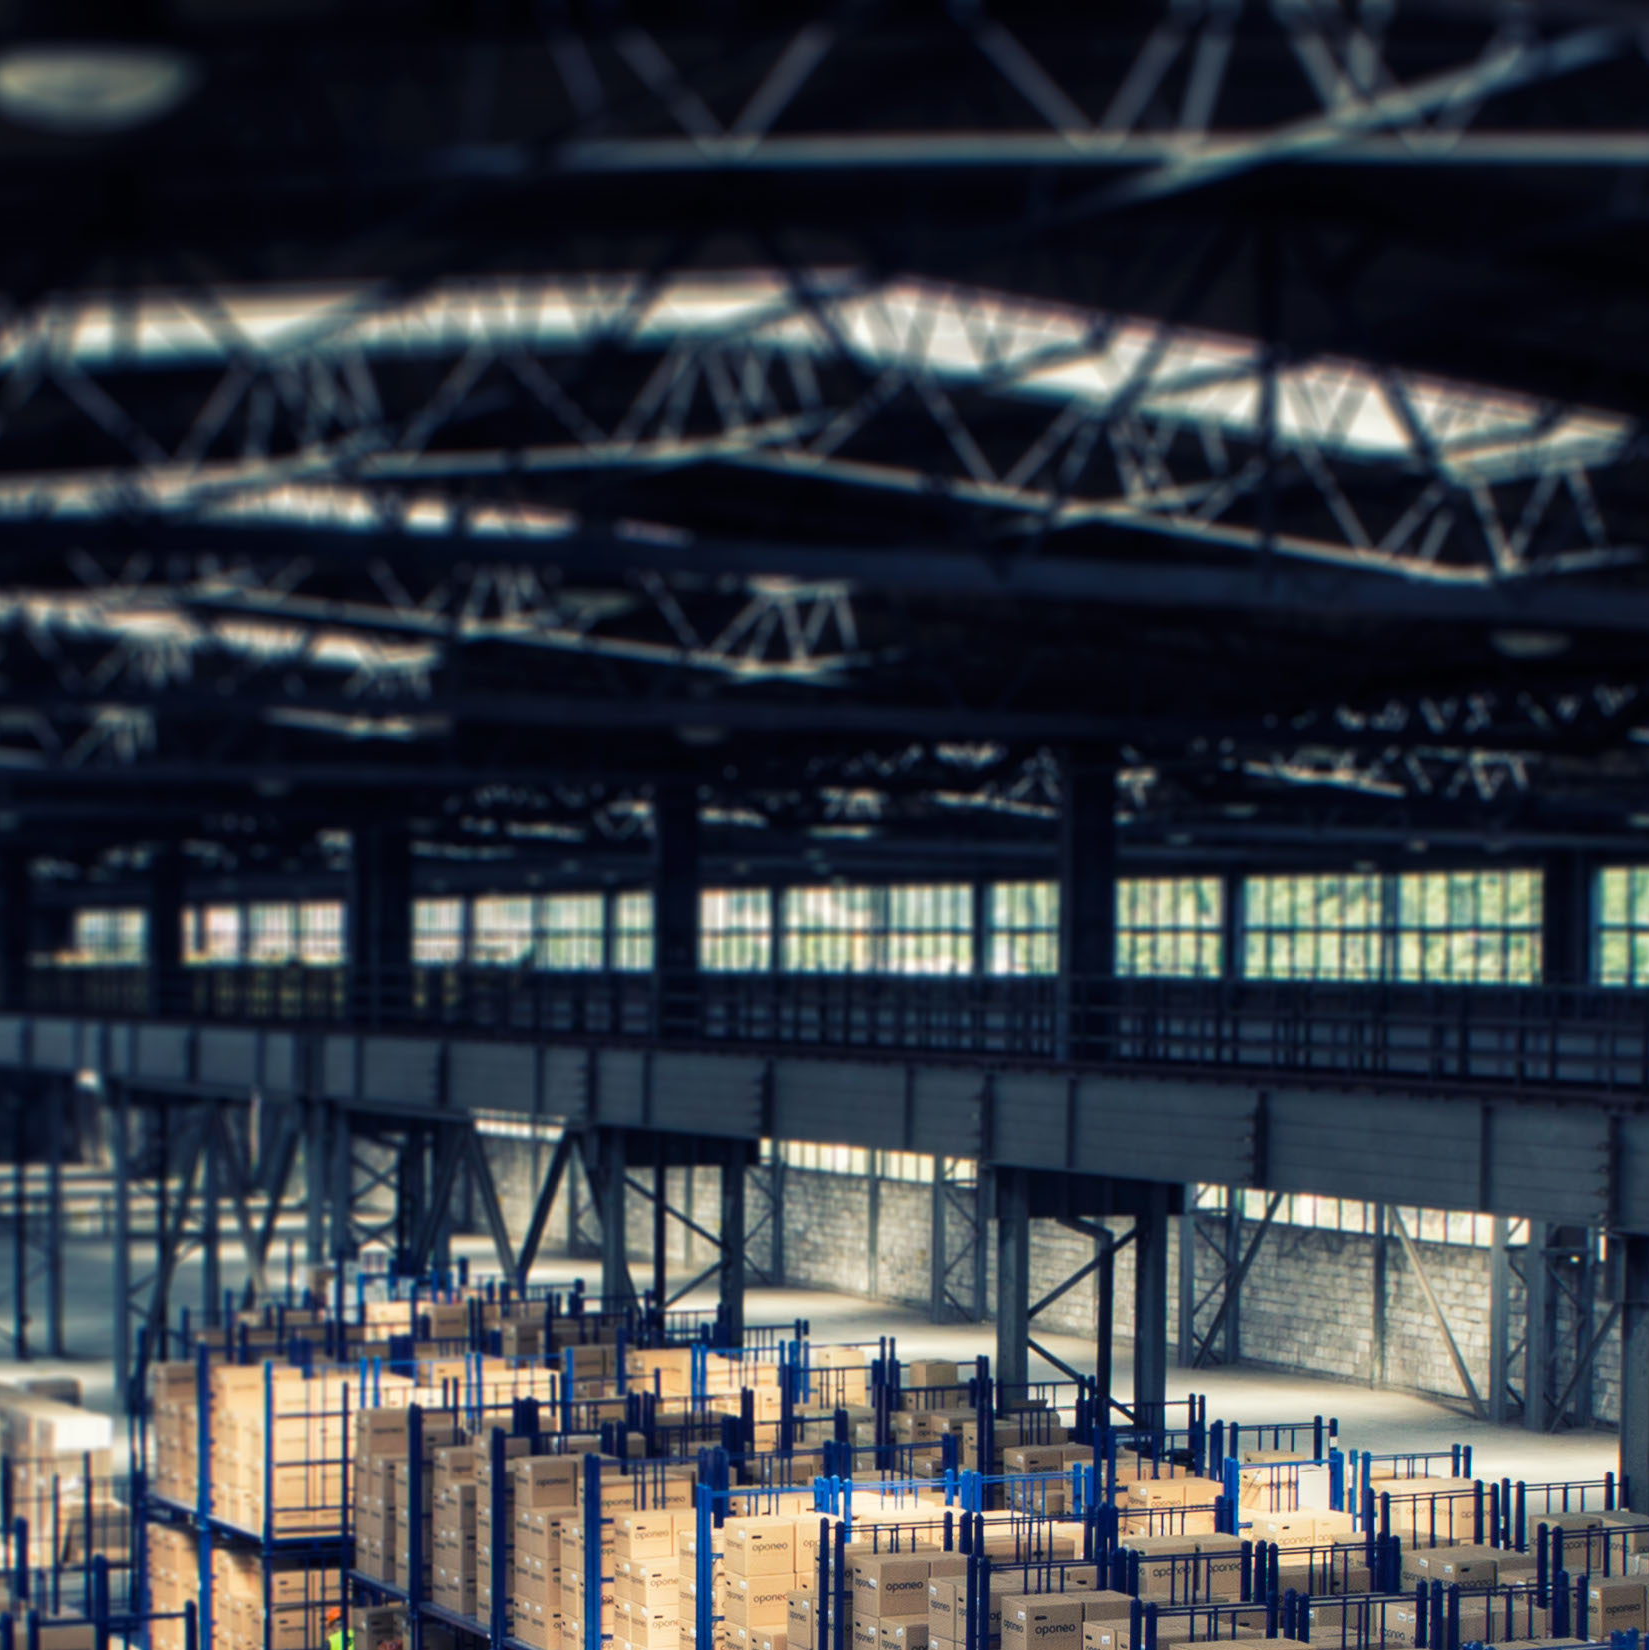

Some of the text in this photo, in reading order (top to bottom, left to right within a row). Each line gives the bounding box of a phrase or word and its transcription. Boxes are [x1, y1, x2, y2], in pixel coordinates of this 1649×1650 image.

[634, 1528, 669, 1539] oponeo
[752, 1541, 788, 1551] oponeo
[885, 1580, 923, 1591] oponeo
[930, 1599, 950, 1612] oponeo
[1606, 1603, 1641, 1616] oponeo
[1003, 1619, 1024, 1633] oponeo
[1035, 1622, 1076, 1636] oponeo
